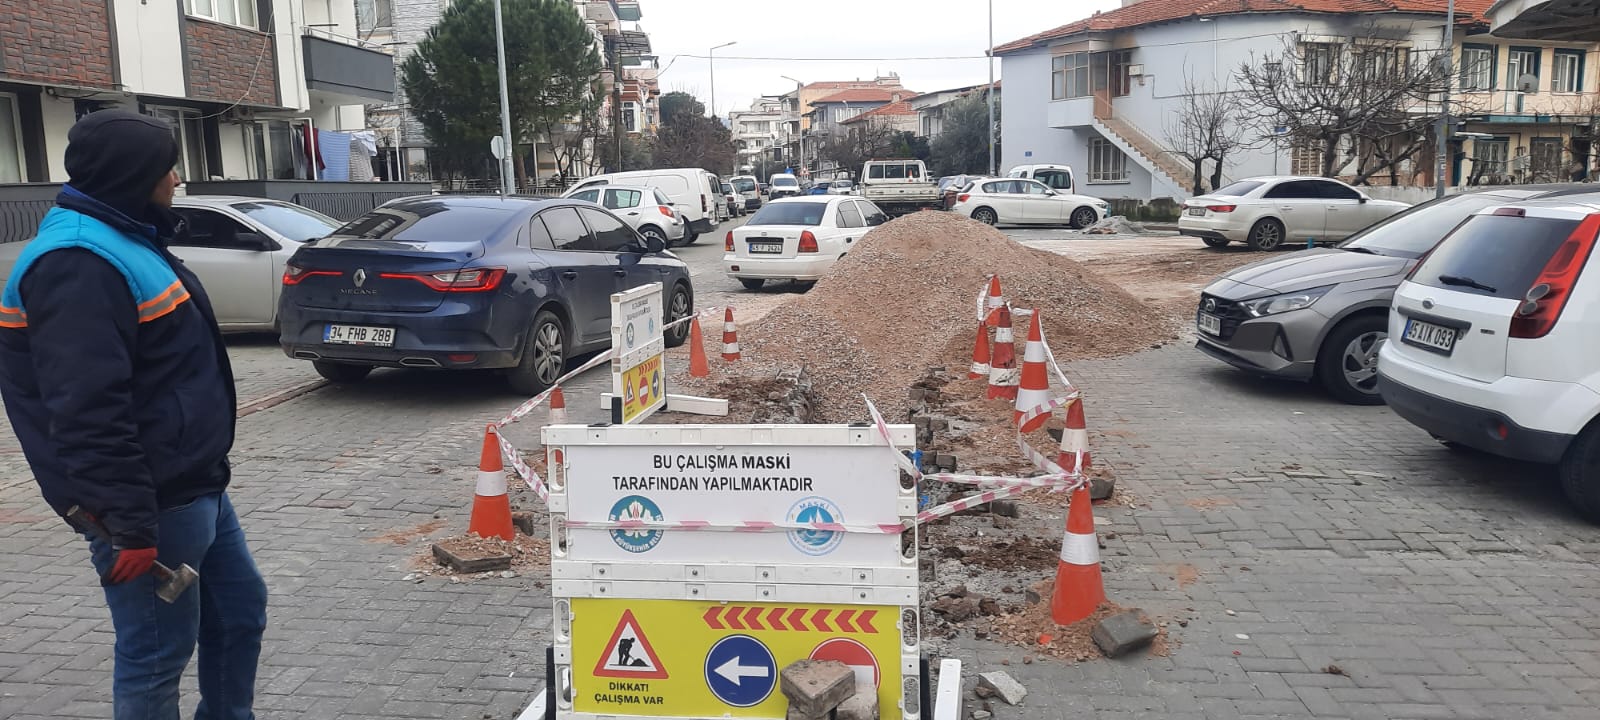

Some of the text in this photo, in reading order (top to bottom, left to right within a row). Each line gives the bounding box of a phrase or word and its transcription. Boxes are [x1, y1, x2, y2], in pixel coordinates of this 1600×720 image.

[330, 326, 392, 342] 34 FHB 288
[1408, 322, 1419, 339] 45
[1434, 328, 1453, 348] 093
[653, 452, 791, 472] BU ÇALIŞMA MASKİ
[612, 476, 813, 492] TARAFINDAN YAPILMAKTADIR
[594, 692, 664, 706] ÇALIŞMA VAR
